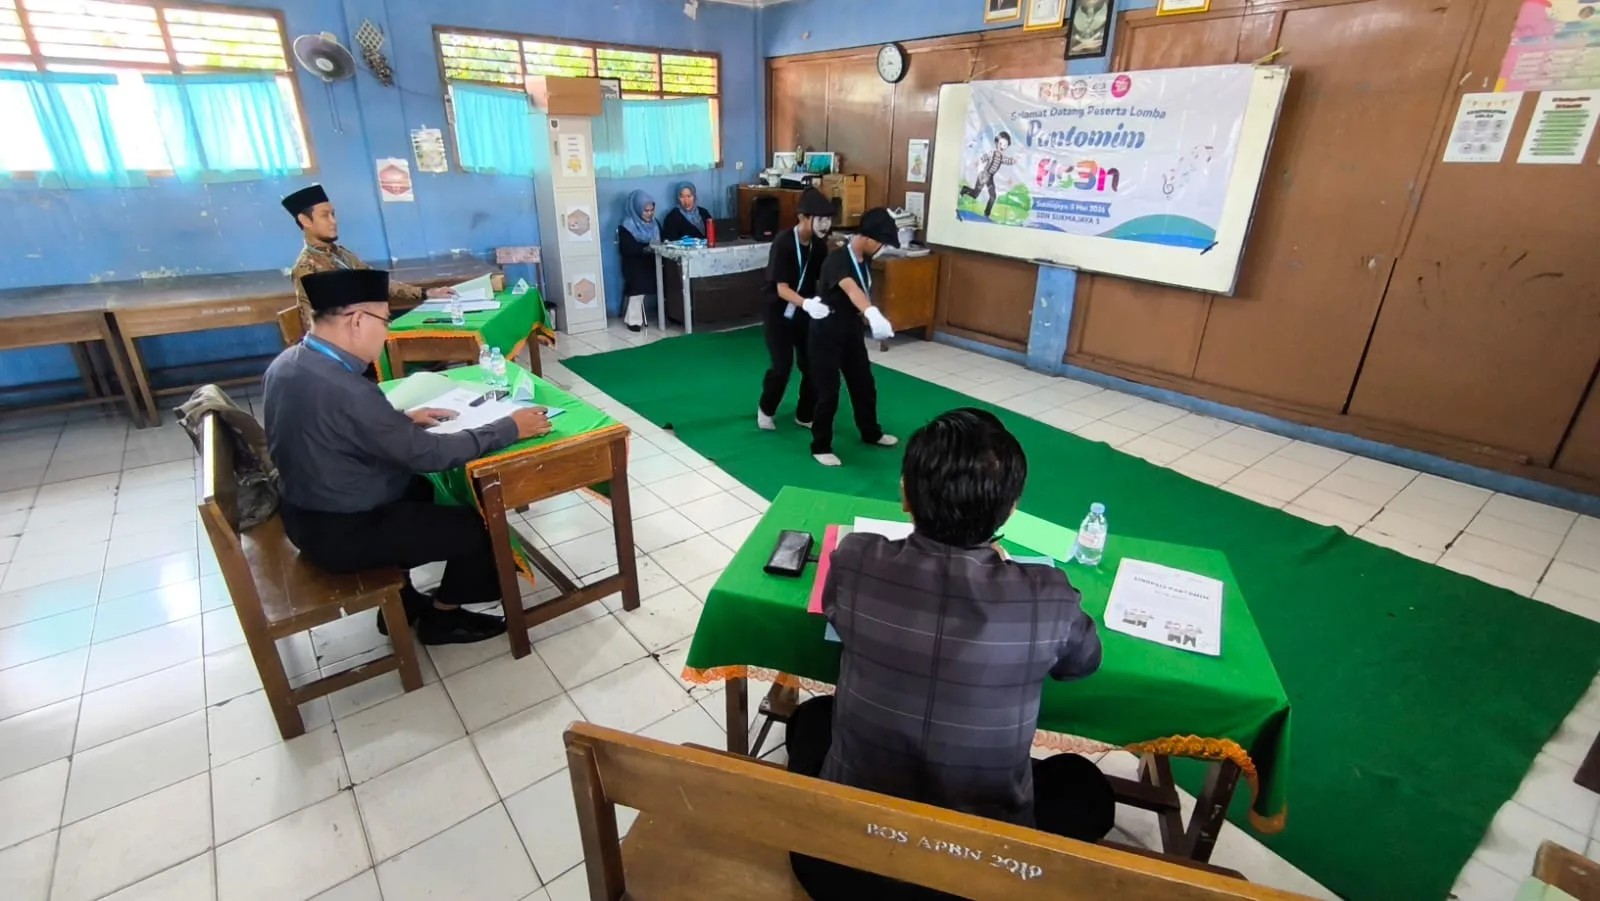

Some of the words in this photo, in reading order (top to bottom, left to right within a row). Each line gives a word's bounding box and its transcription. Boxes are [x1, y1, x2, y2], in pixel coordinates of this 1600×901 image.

[1011, 109, 1048, 121] Selamat
[1050, 106, 1085, 118] Datang
[1087, 105, 1127, 116] Peserta
[1129, 106, 1167, 119] Lomba
[1026, 120, 1145, 148] Pantomim
[866, 823, 908, 843] BOS
[917, 836, 982, 861] APBN
